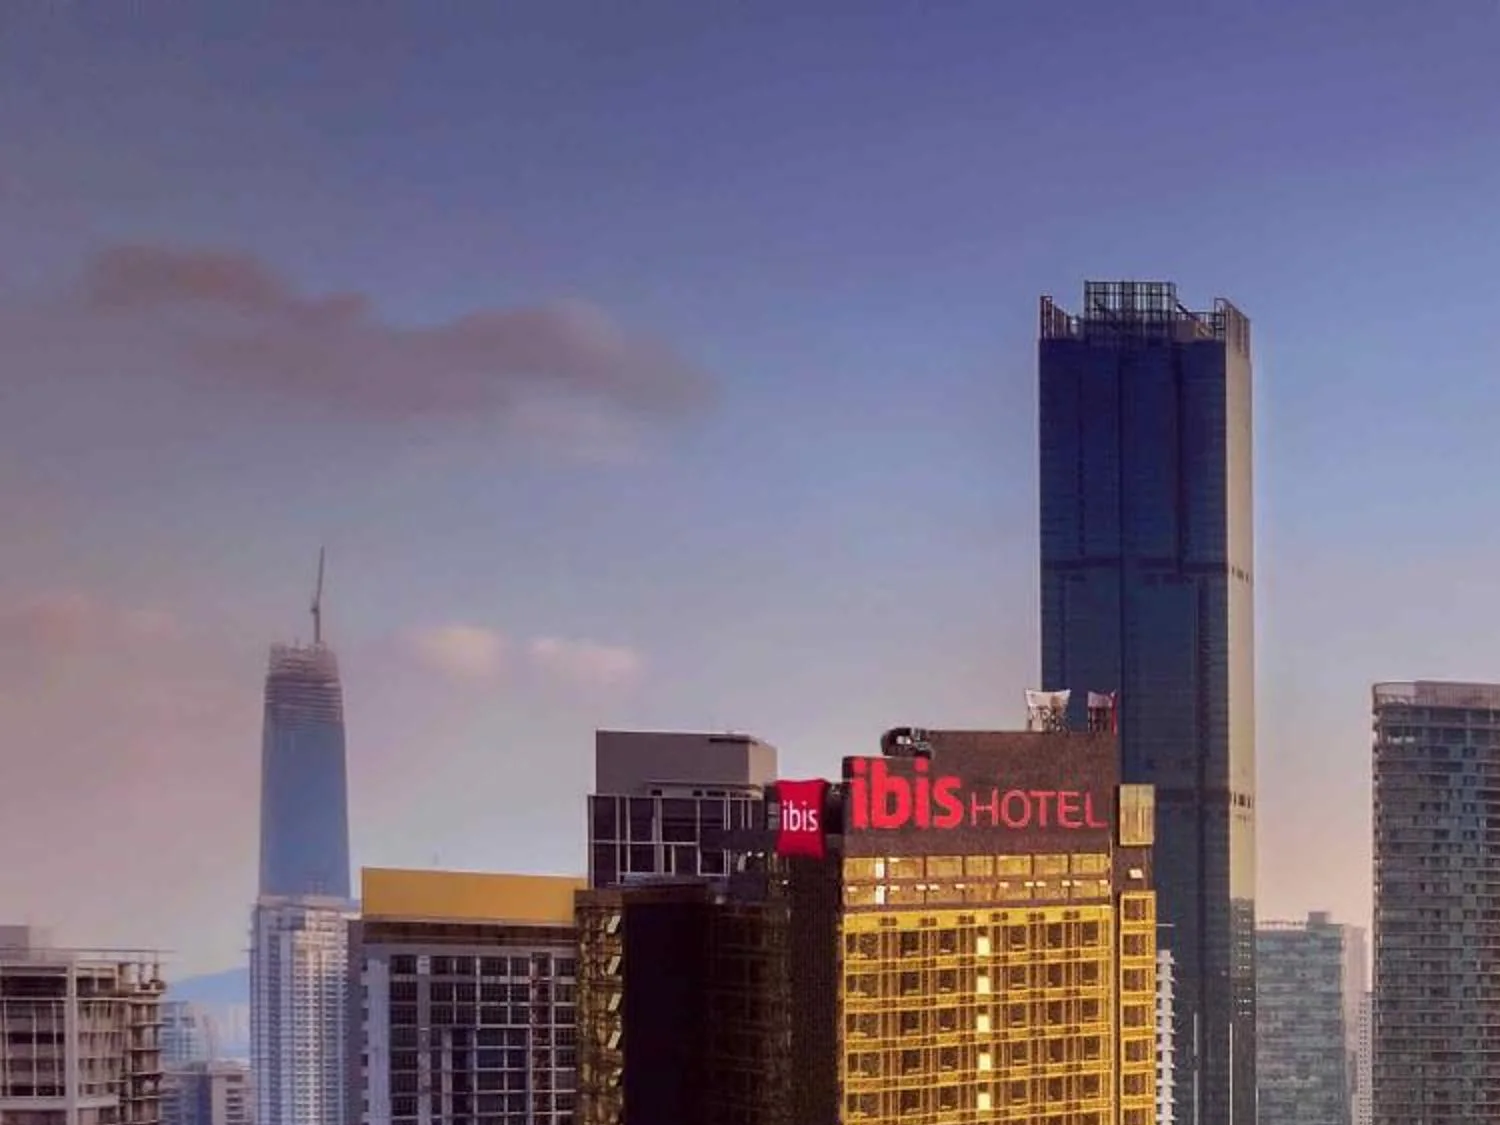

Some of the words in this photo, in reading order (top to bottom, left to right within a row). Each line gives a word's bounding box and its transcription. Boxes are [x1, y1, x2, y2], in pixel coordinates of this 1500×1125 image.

[783, 799, 819, 832] ibis
[852, 757, 965, 829] ibis
[969, 788, 1108, 829] HOTEL
